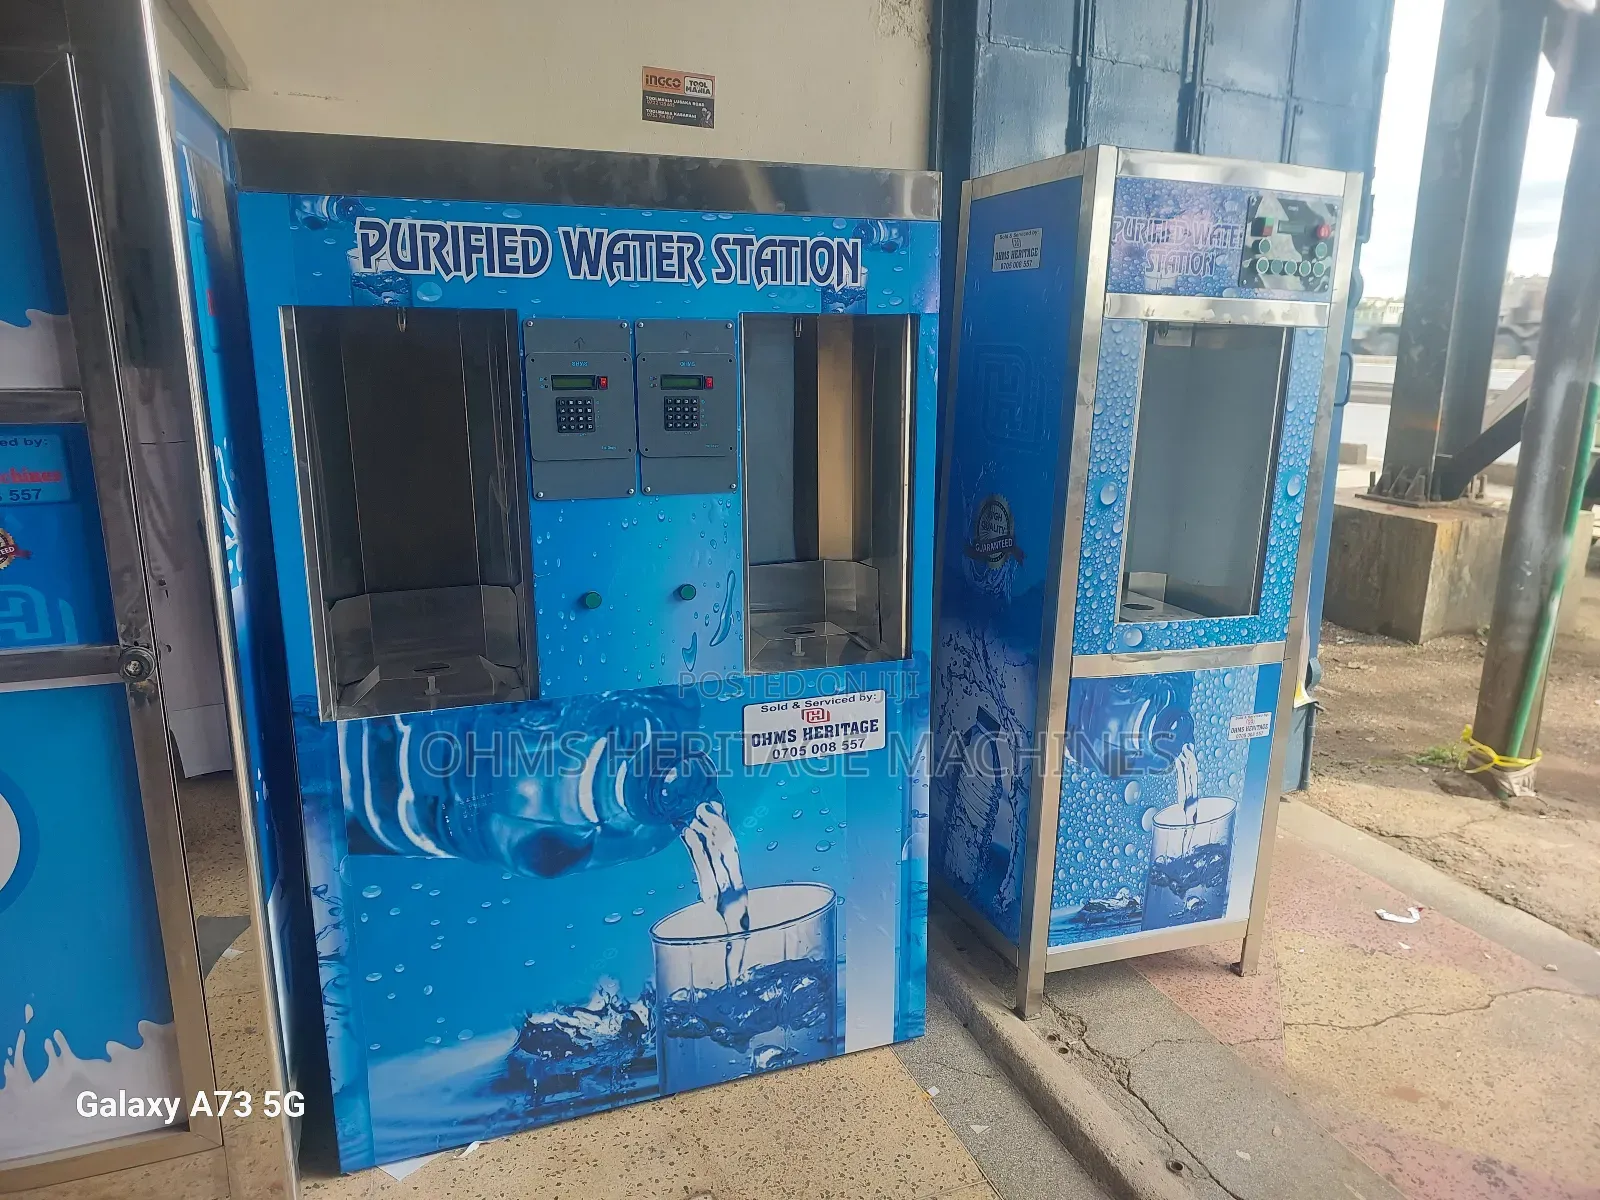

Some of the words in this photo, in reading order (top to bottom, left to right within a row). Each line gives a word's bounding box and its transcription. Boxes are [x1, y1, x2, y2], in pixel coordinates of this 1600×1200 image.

[686, 86, 710, 94] MANIA
[1112, 215, 1188, 247] PURIFIED
[355, 217, 552, 283] PURIFIED
[558, 226, 707, 290] WATER
[711, 233, 862, 292] STATION
[1010, 247, 1039, 259] HERITAGE
[1145, 248, 1216, 277] STATION
[1023, 259, 1033, 268] 557
[23, 437, 48, 448] by:
[9, 488, 42, 501] 557
[761, 702, 788, 713] Sold
[792, 701, 801, 709] &
[805, 695, 856, 708] Serviced
[860, 693, 877, 702] by:
[751, 729, 797, 747] OHMS
[803, 719, 879, 741] HERITAGE
[772, 747, 807, 760] 0705
[811, 741, 837, 755] 008
[841, 738, 866, 751] 557
